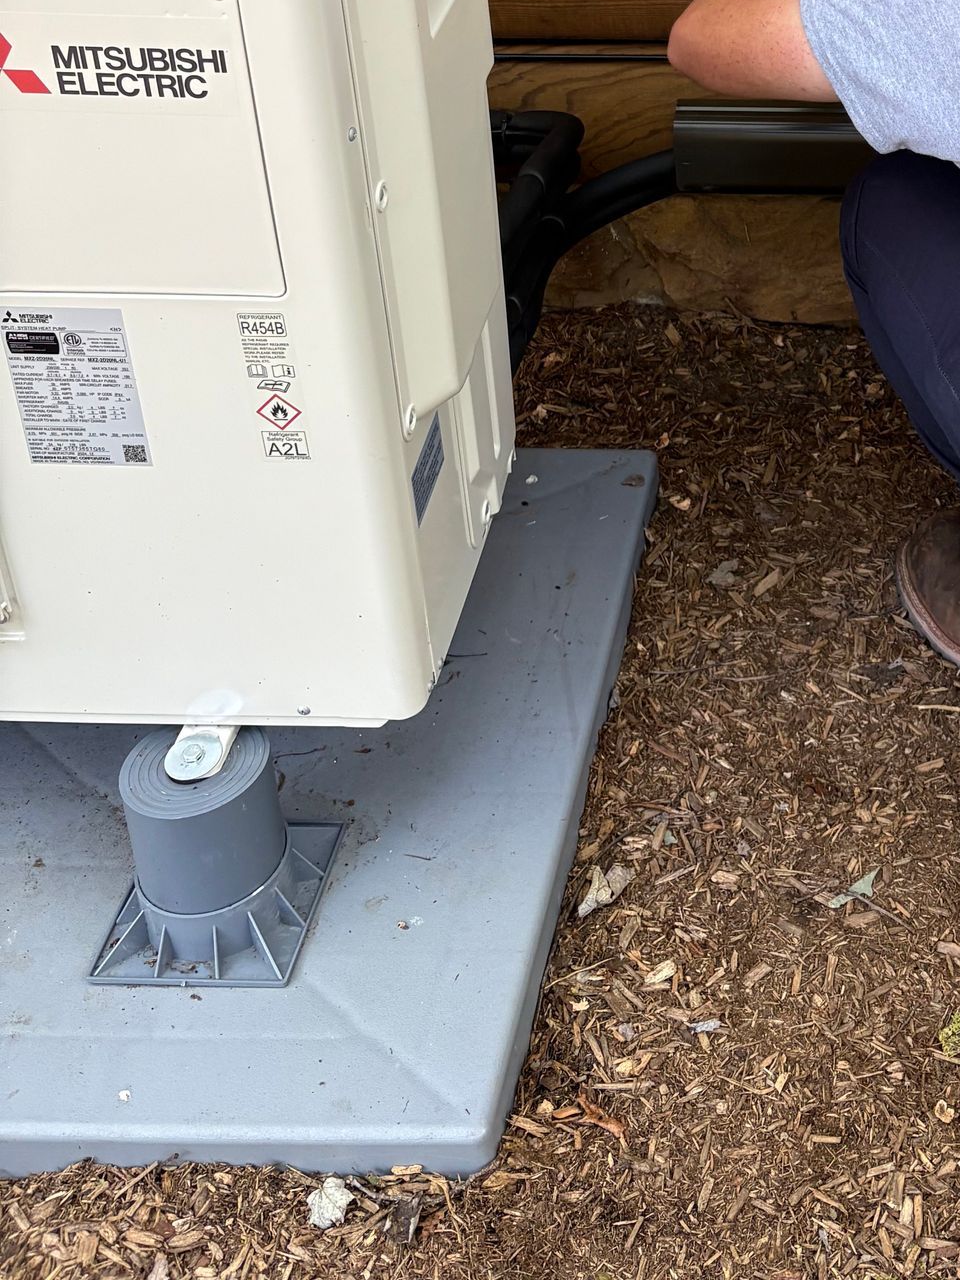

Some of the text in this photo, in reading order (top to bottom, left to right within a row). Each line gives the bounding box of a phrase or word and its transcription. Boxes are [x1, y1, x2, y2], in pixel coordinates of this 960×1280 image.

[51, 45, 228, 73] MITSUBISHI
[56, 71, 209, 99] ELECTRIC
[241, 321, 284, 335] R454B
[269, 443, 307, 455] A2L
